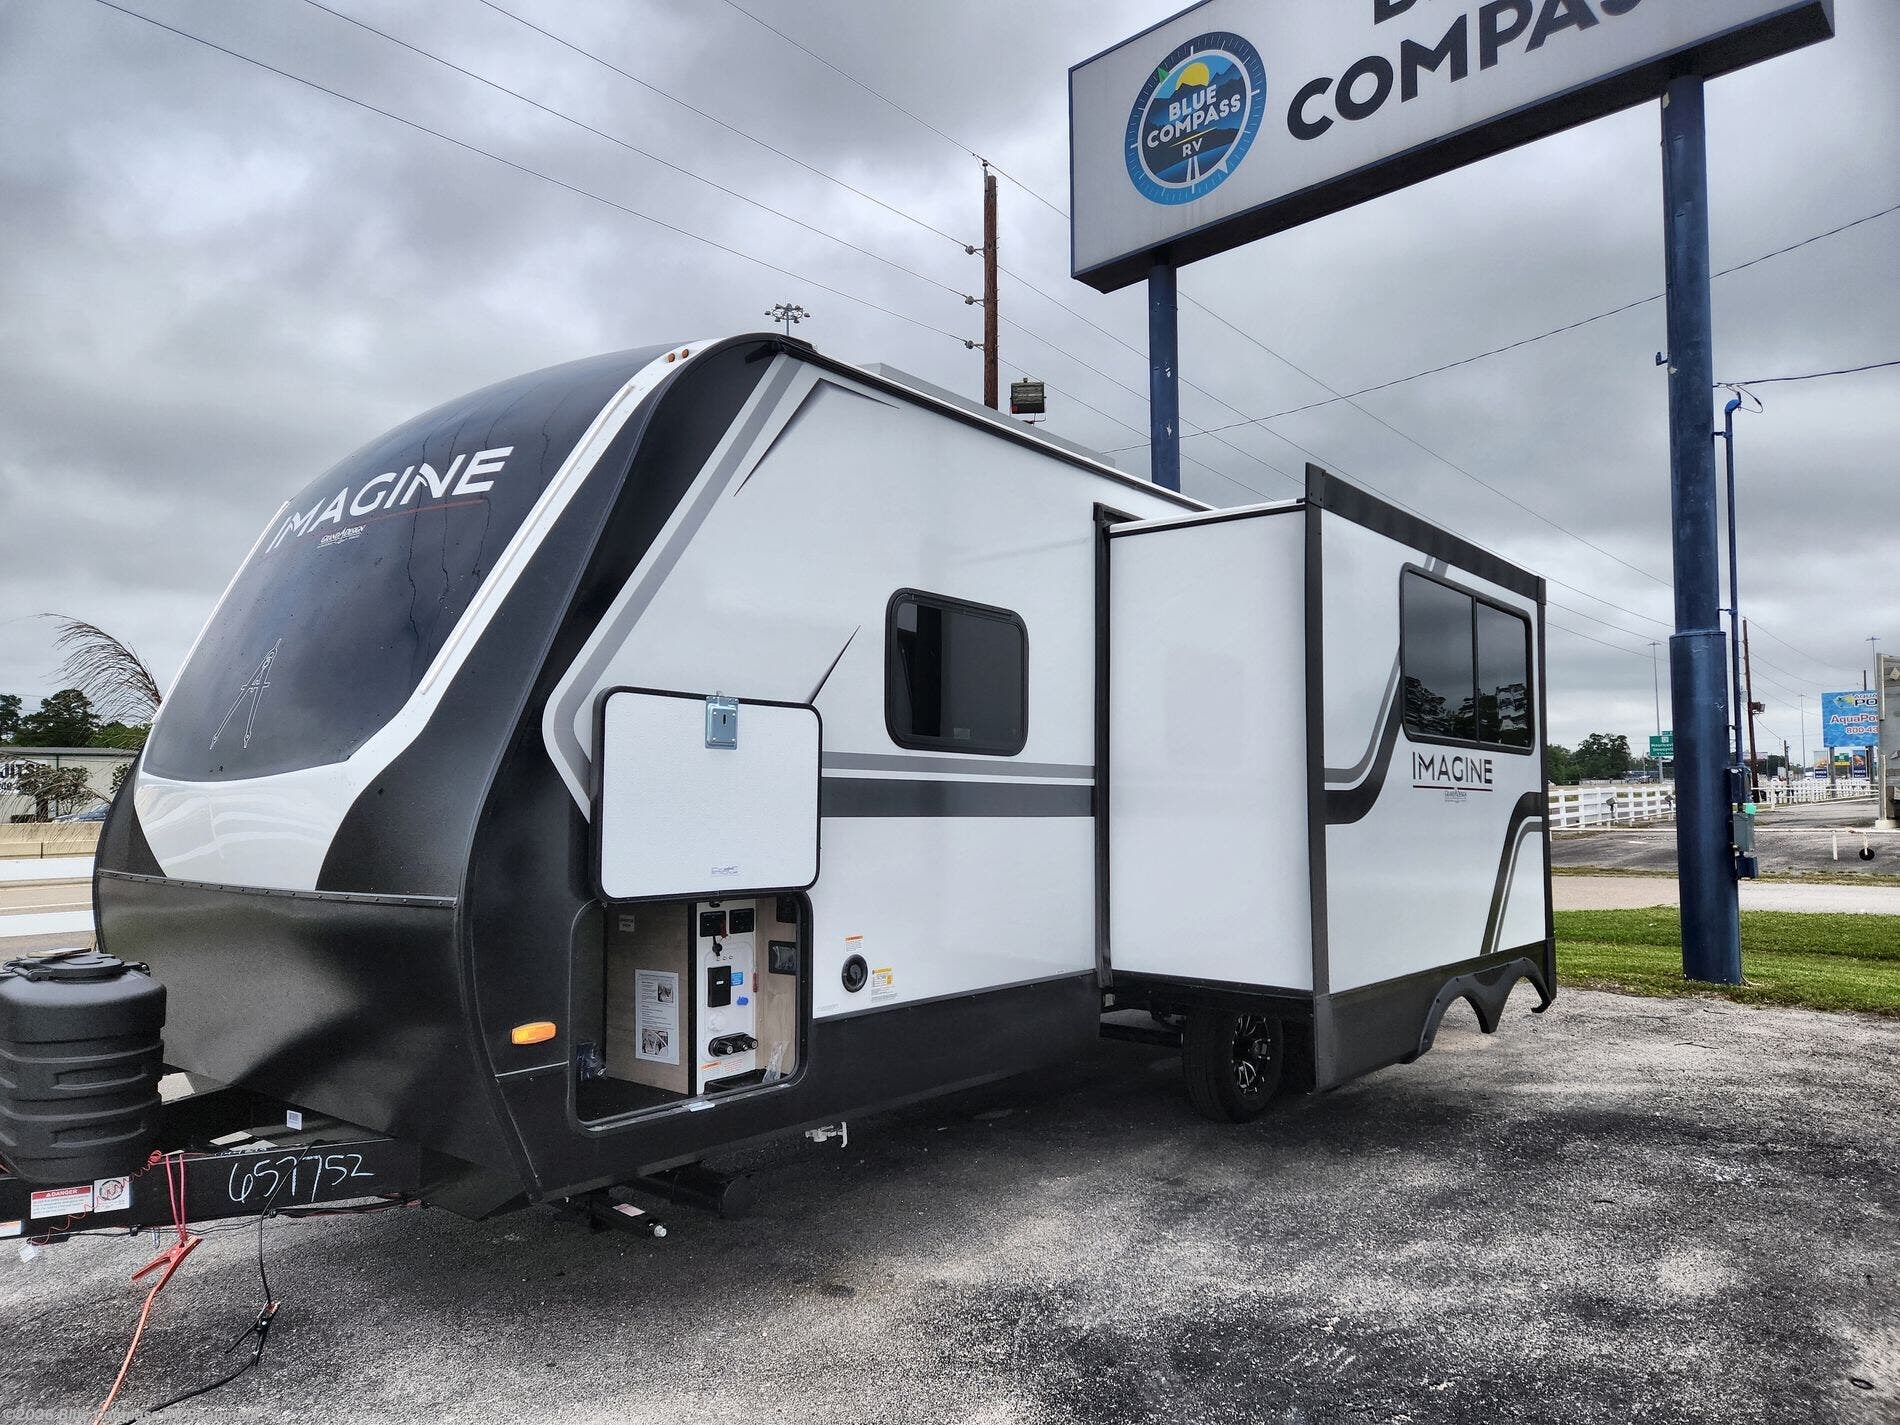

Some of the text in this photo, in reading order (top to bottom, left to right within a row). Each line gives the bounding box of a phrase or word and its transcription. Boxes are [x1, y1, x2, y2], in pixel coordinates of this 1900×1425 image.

[1287, 0, 1642, 141] COMPA
[1146, 94, 1241, 148] COMPASS
[1168, 84, 1217, 122] BLUE
[1182, 138, 1203, 158] RV
[265, 446, 515, 554] IMAGINE
[1412, 751, 1493, 784] IMAGINE
[54, 1189, 78, 1198] DANGER
[228, 1154, 375, 1204] 657752
